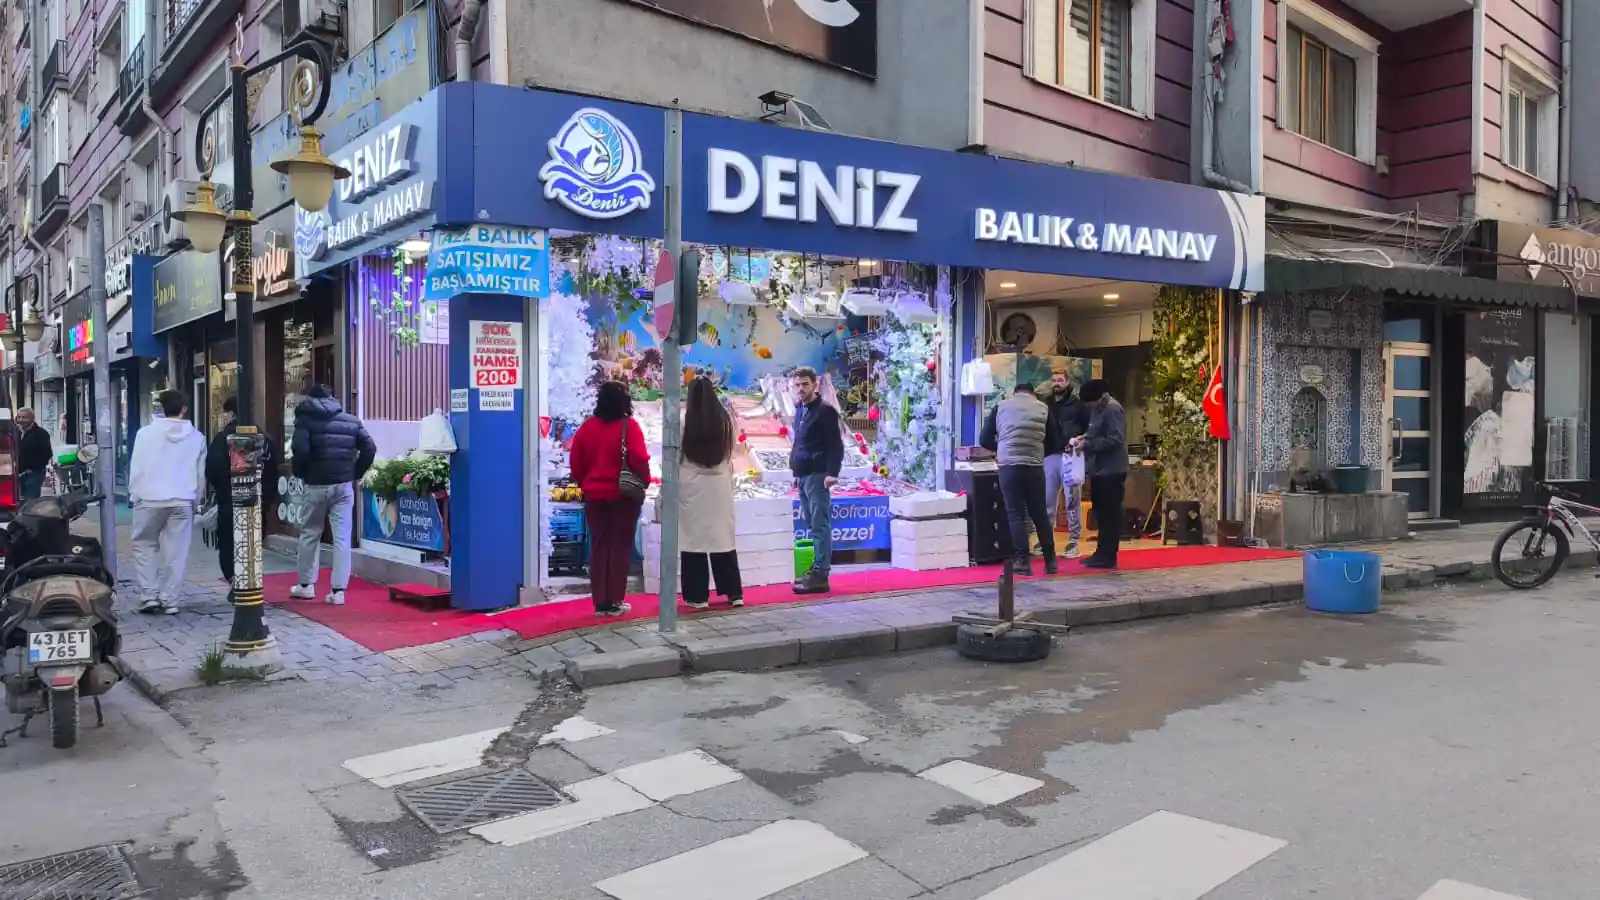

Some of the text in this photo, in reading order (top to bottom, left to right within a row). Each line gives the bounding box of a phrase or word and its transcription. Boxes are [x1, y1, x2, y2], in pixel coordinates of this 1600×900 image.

[327, 213, 359, 249] BALIK
[361, 211, 369, 233] &
[373, 180, 425, 229] MANAV
[478, 227, 537, 246] BALIK
[975, 207, 1218, 262] BALIK & MANAV
[437, 250, 533, 271] SATIŞIMIZ
[431, 272, 540, 293] BAŞLAMIŞTIR
[33, 631, 87, 645] 43 AET
[47, 646, 77, 659] 765
